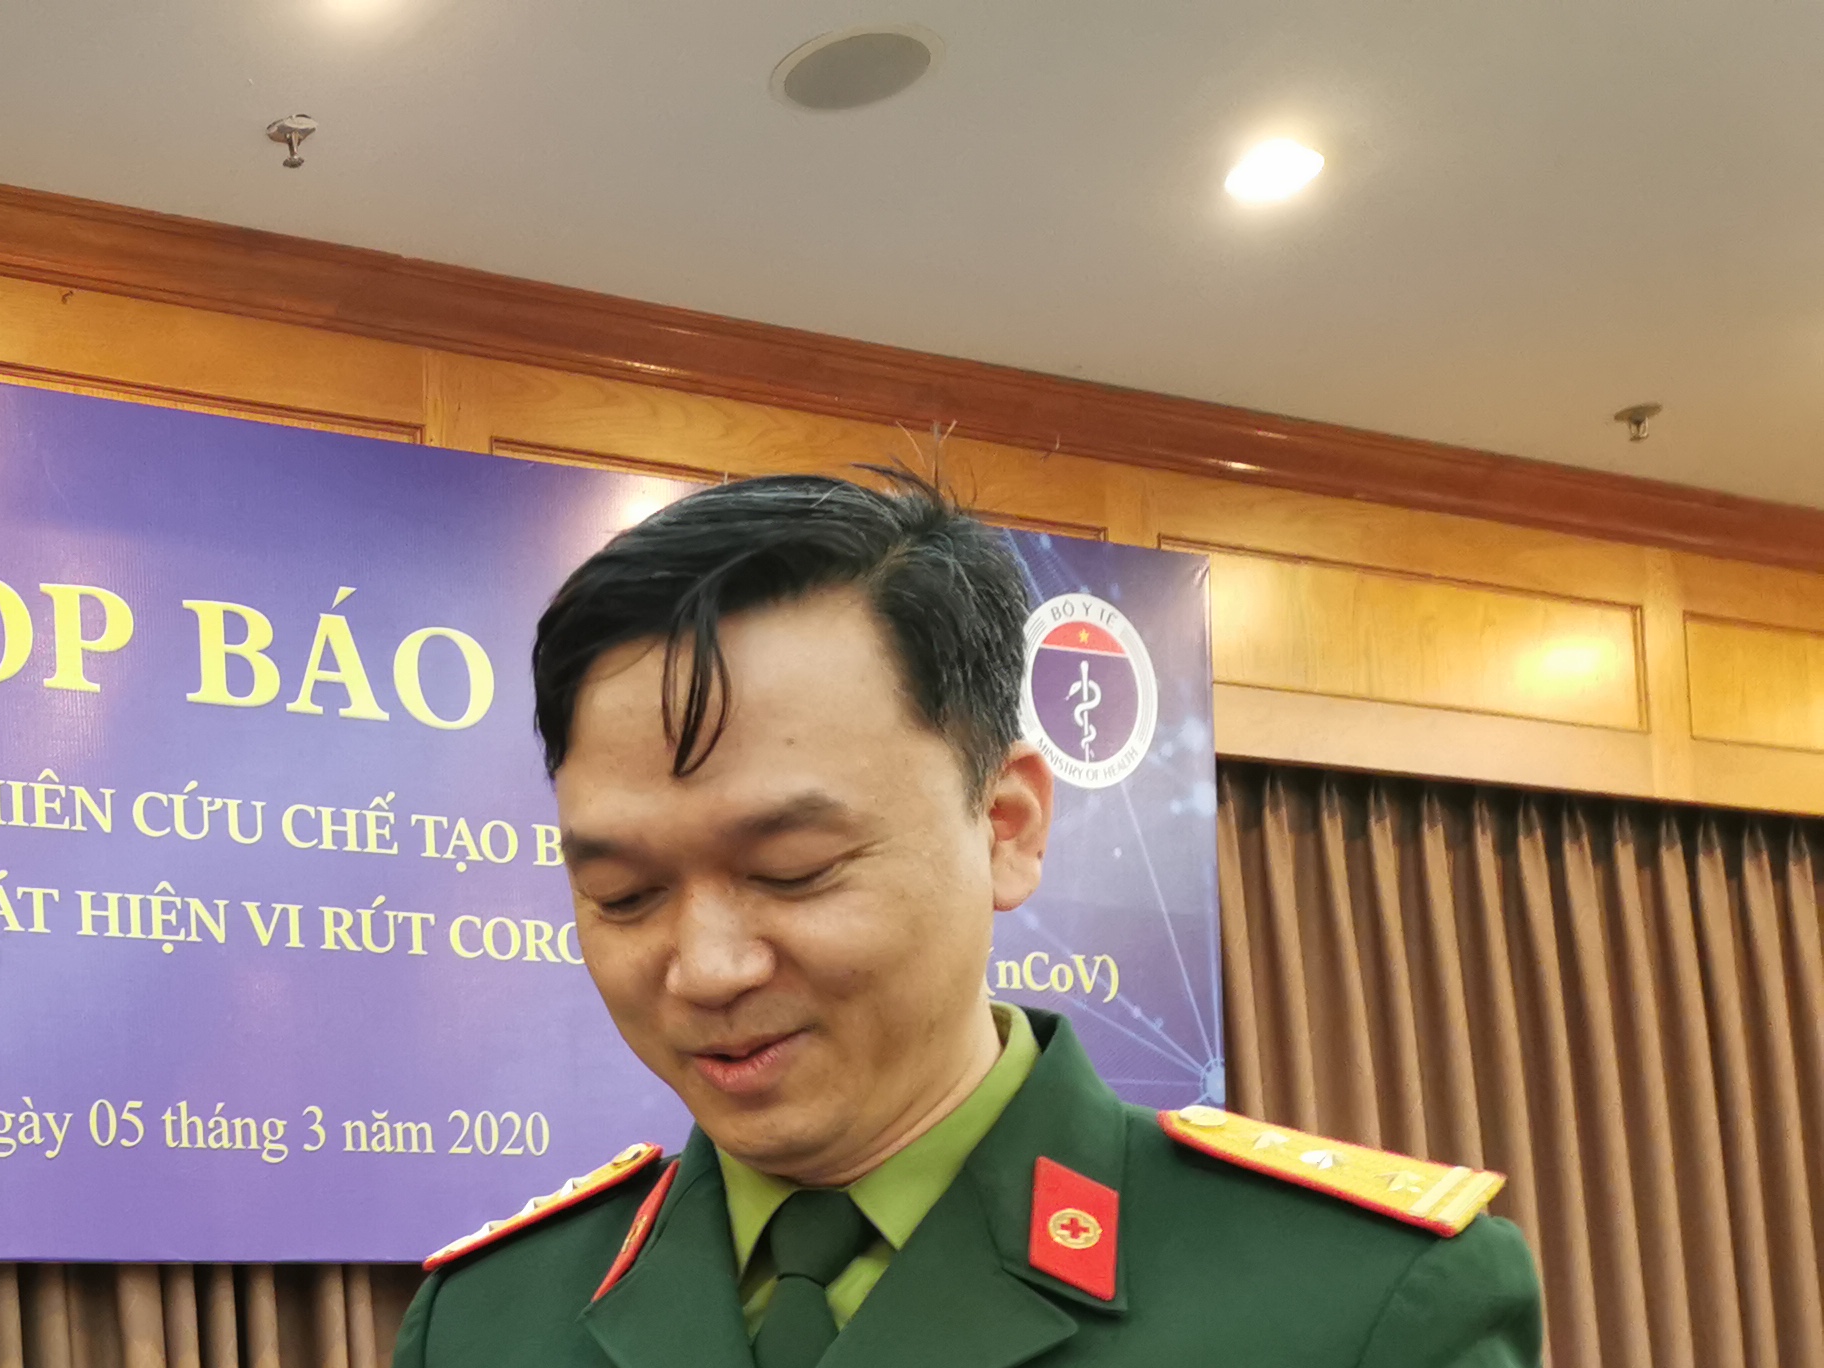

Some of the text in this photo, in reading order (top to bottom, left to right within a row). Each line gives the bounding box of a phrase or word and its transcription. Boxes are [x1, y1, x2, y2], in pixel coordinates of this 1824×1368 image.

[182, 586, 494, 730] BÁO
[132, 780, 266, 844] CỨU
[282, 791, 398, 855] CHẾ
[411, 814, 518, 872] TẠO
[532, 824, 565, 866] B
[75, 881, 229, 954] HIỆN
[241, 901, 305, 948] VI
[319, 895, 435, 955] RÚT
[449, 915, 585, 964] CORO
[89, 1099, 144, 1147] 05
[162, 1101, 288, 1163] tháng
[302, 1106, 326, 1152] 3
[342, 1109, 435, 1154] năm
[448, 1109, 549, 1156] 2020
